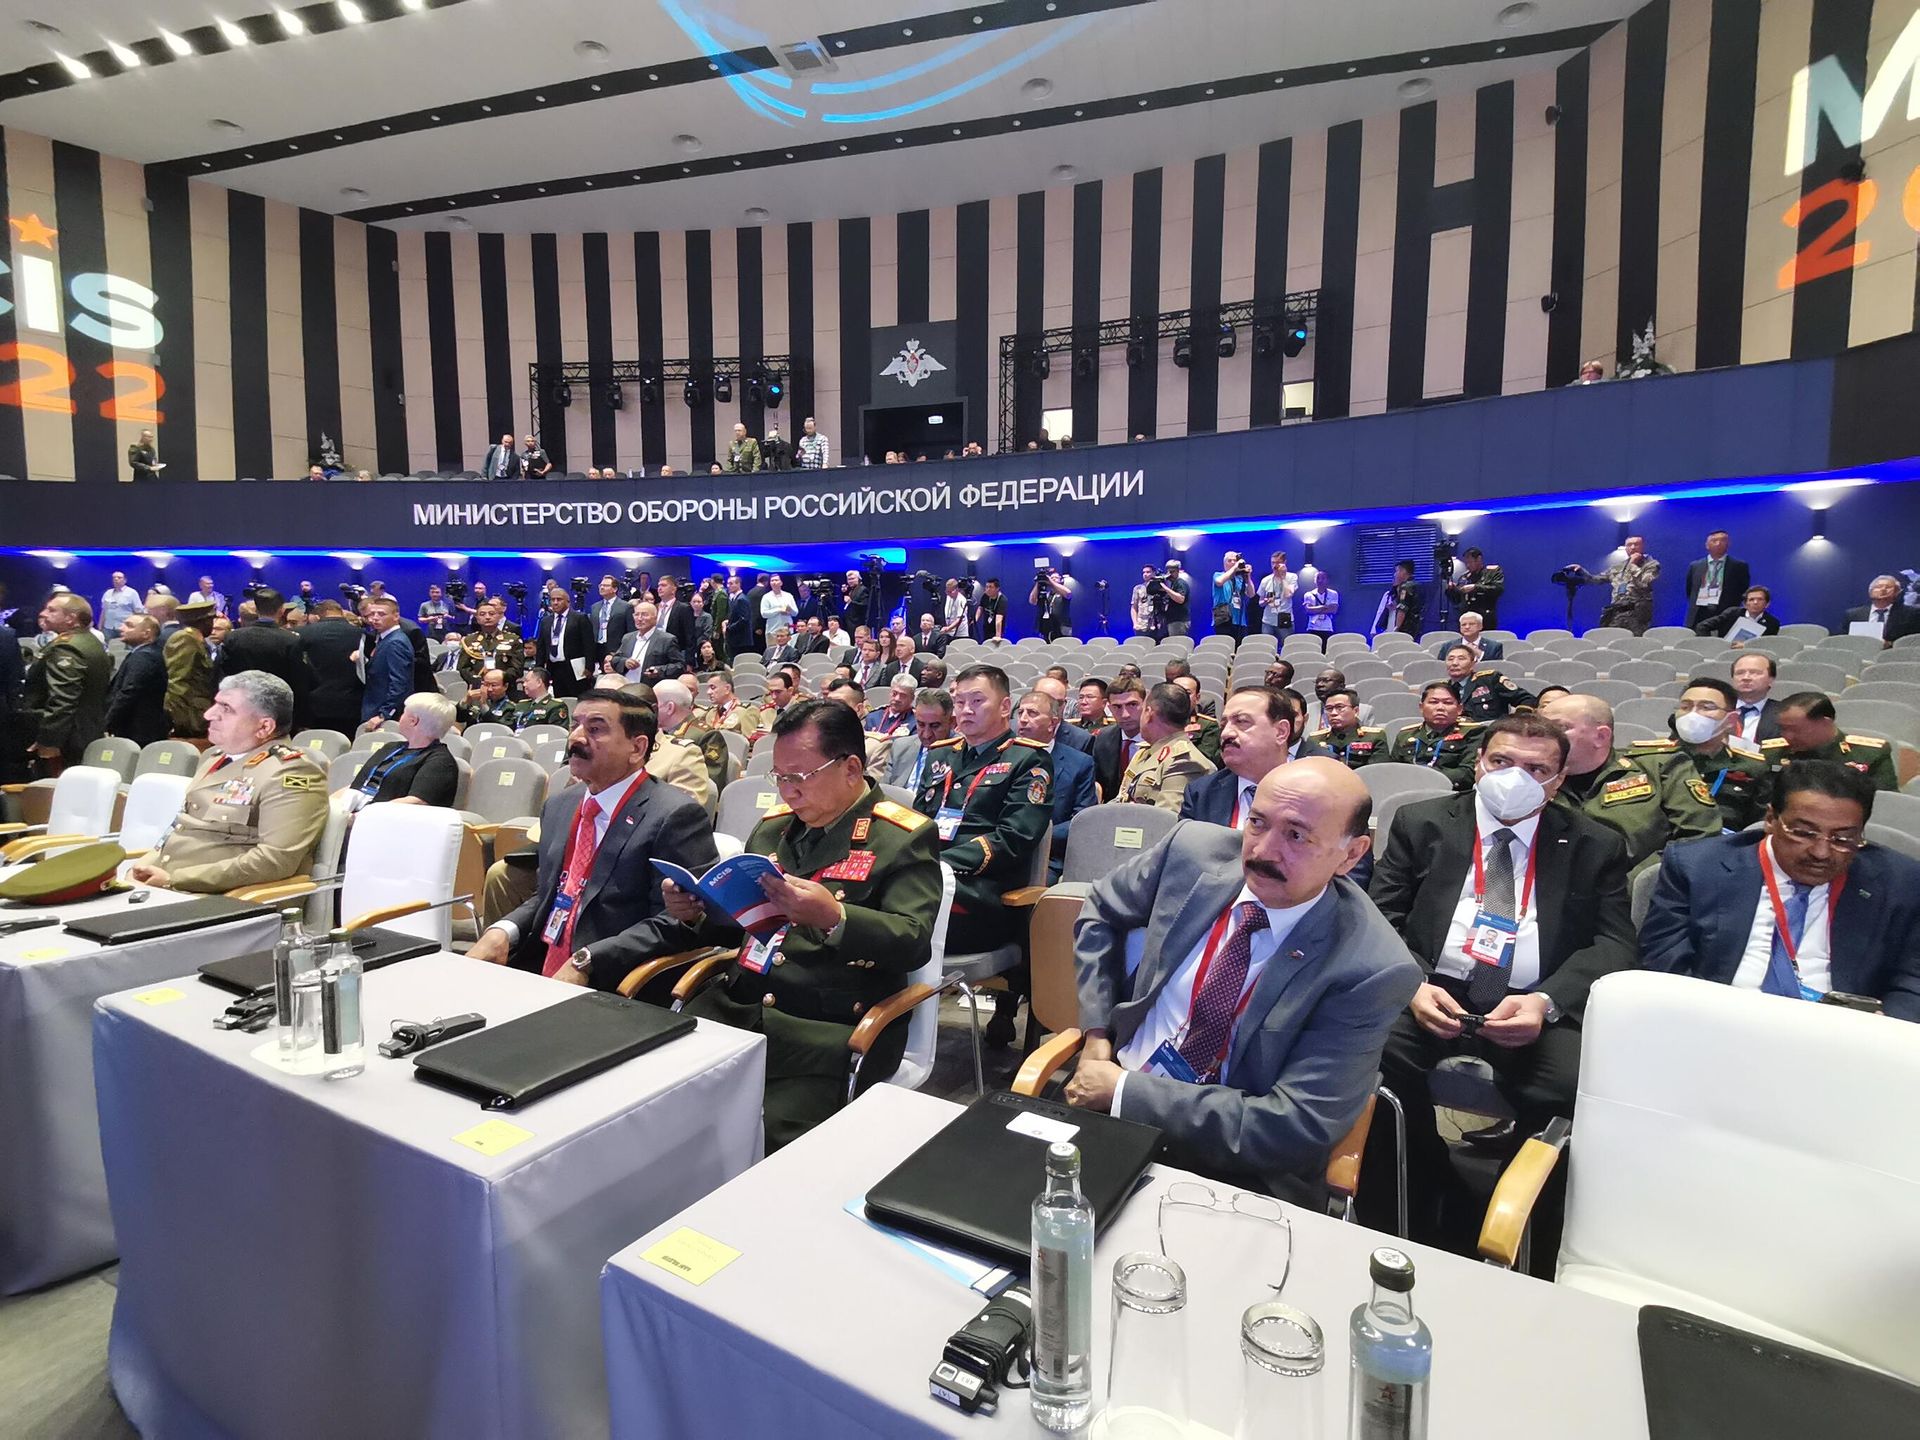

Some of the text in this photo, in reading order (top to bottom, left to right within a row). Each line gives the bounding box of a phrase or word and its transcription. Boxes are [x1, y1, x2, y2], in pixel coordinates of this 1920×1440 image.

[413, 470, 1144, 525] МИНИСТЕРСТВО ОБОРОНЫ РОССИЙСКОЙ ФЕДЕРАЦИИ
[709, 867, 733, 887] MCIS
